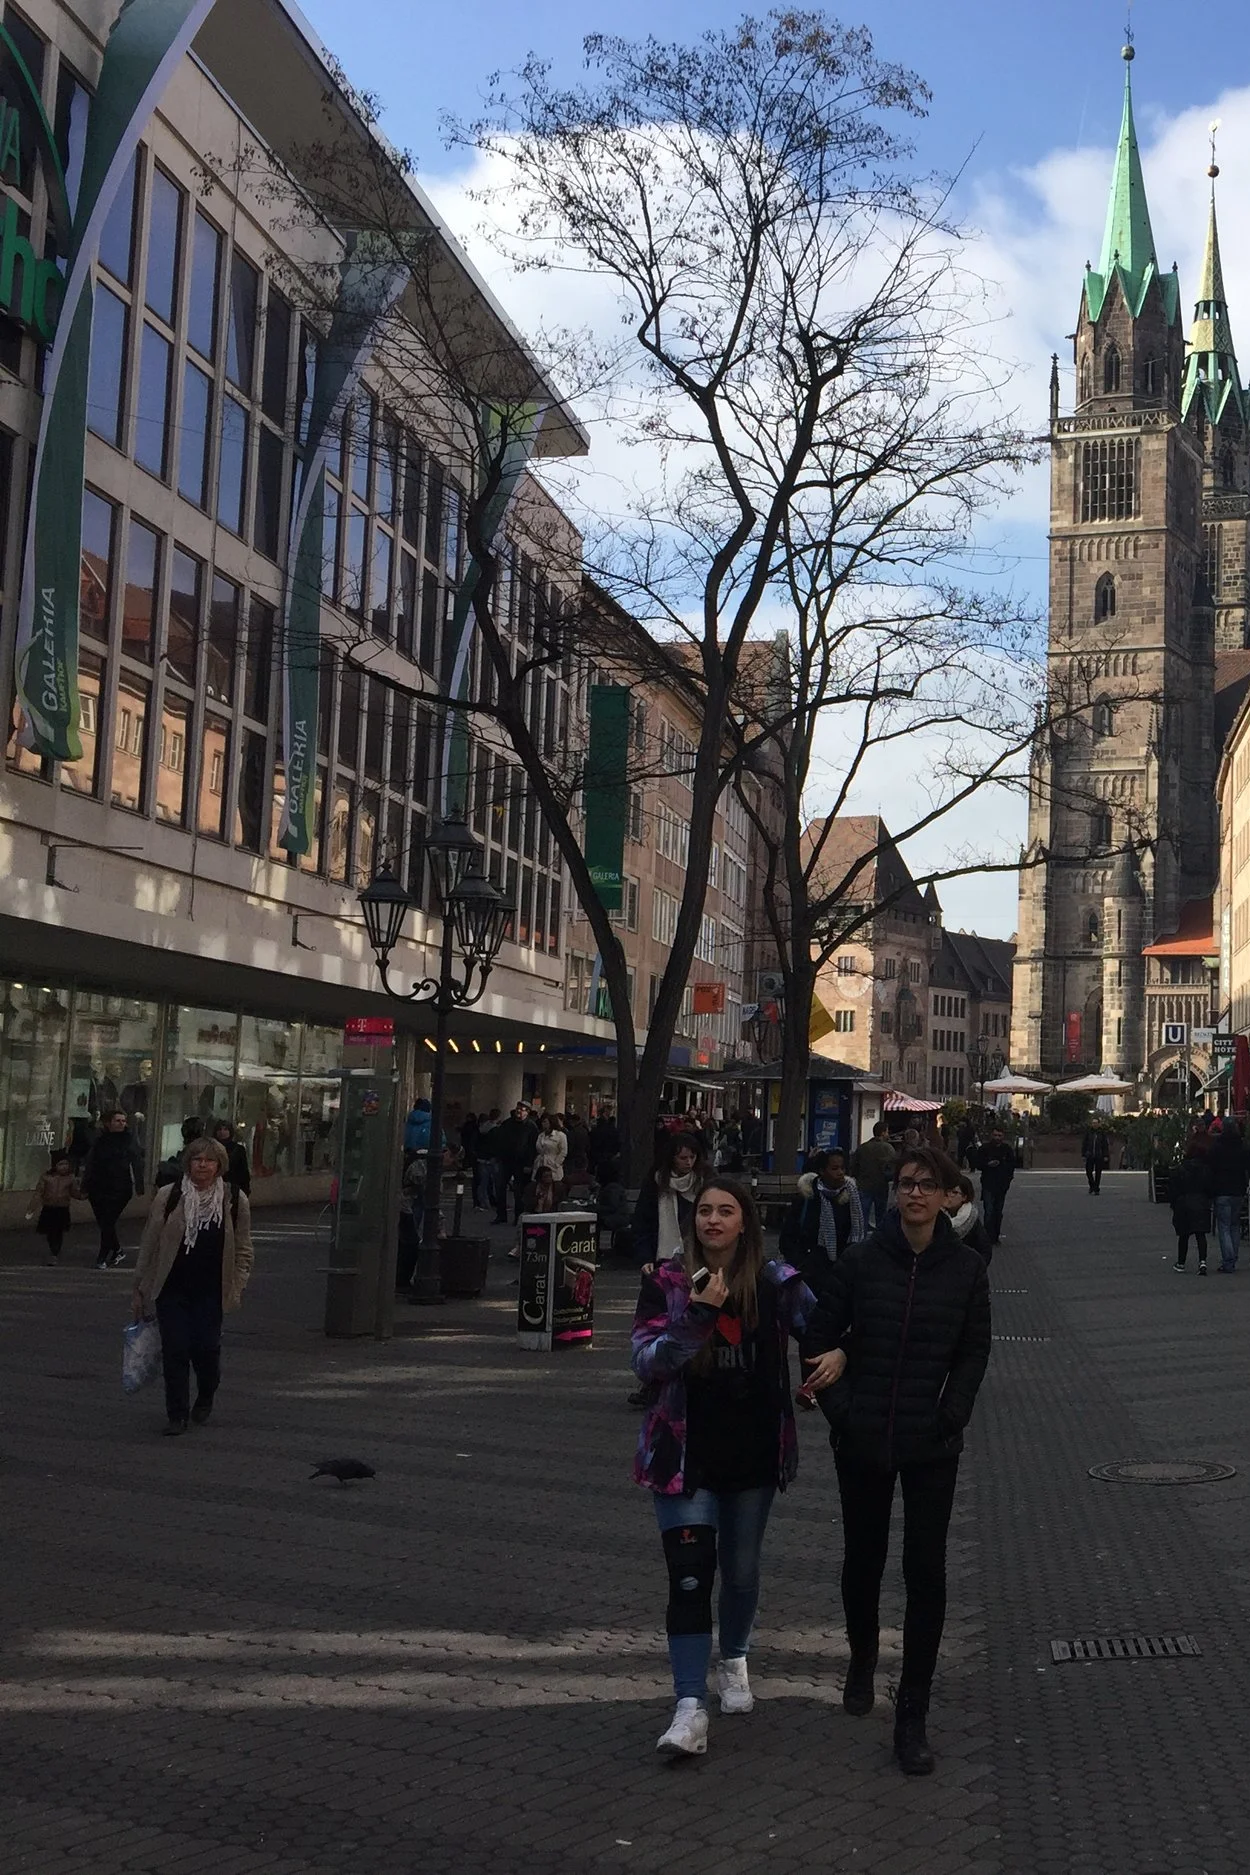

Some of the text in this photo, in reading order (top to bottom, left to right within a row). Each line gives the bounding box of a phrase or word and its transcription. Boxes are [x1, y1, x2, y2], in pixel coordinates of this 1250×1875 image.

[42, 587, 58, 712] GALERIA
[289, 719, 307, 814] GALERIA
[592, 871, 620, 881] GALERIA
[1168, 1026, 1181, 1043] U
[556, 1223, 596, 1254] Carat
[522, 1273, 546, 1325] Carat
